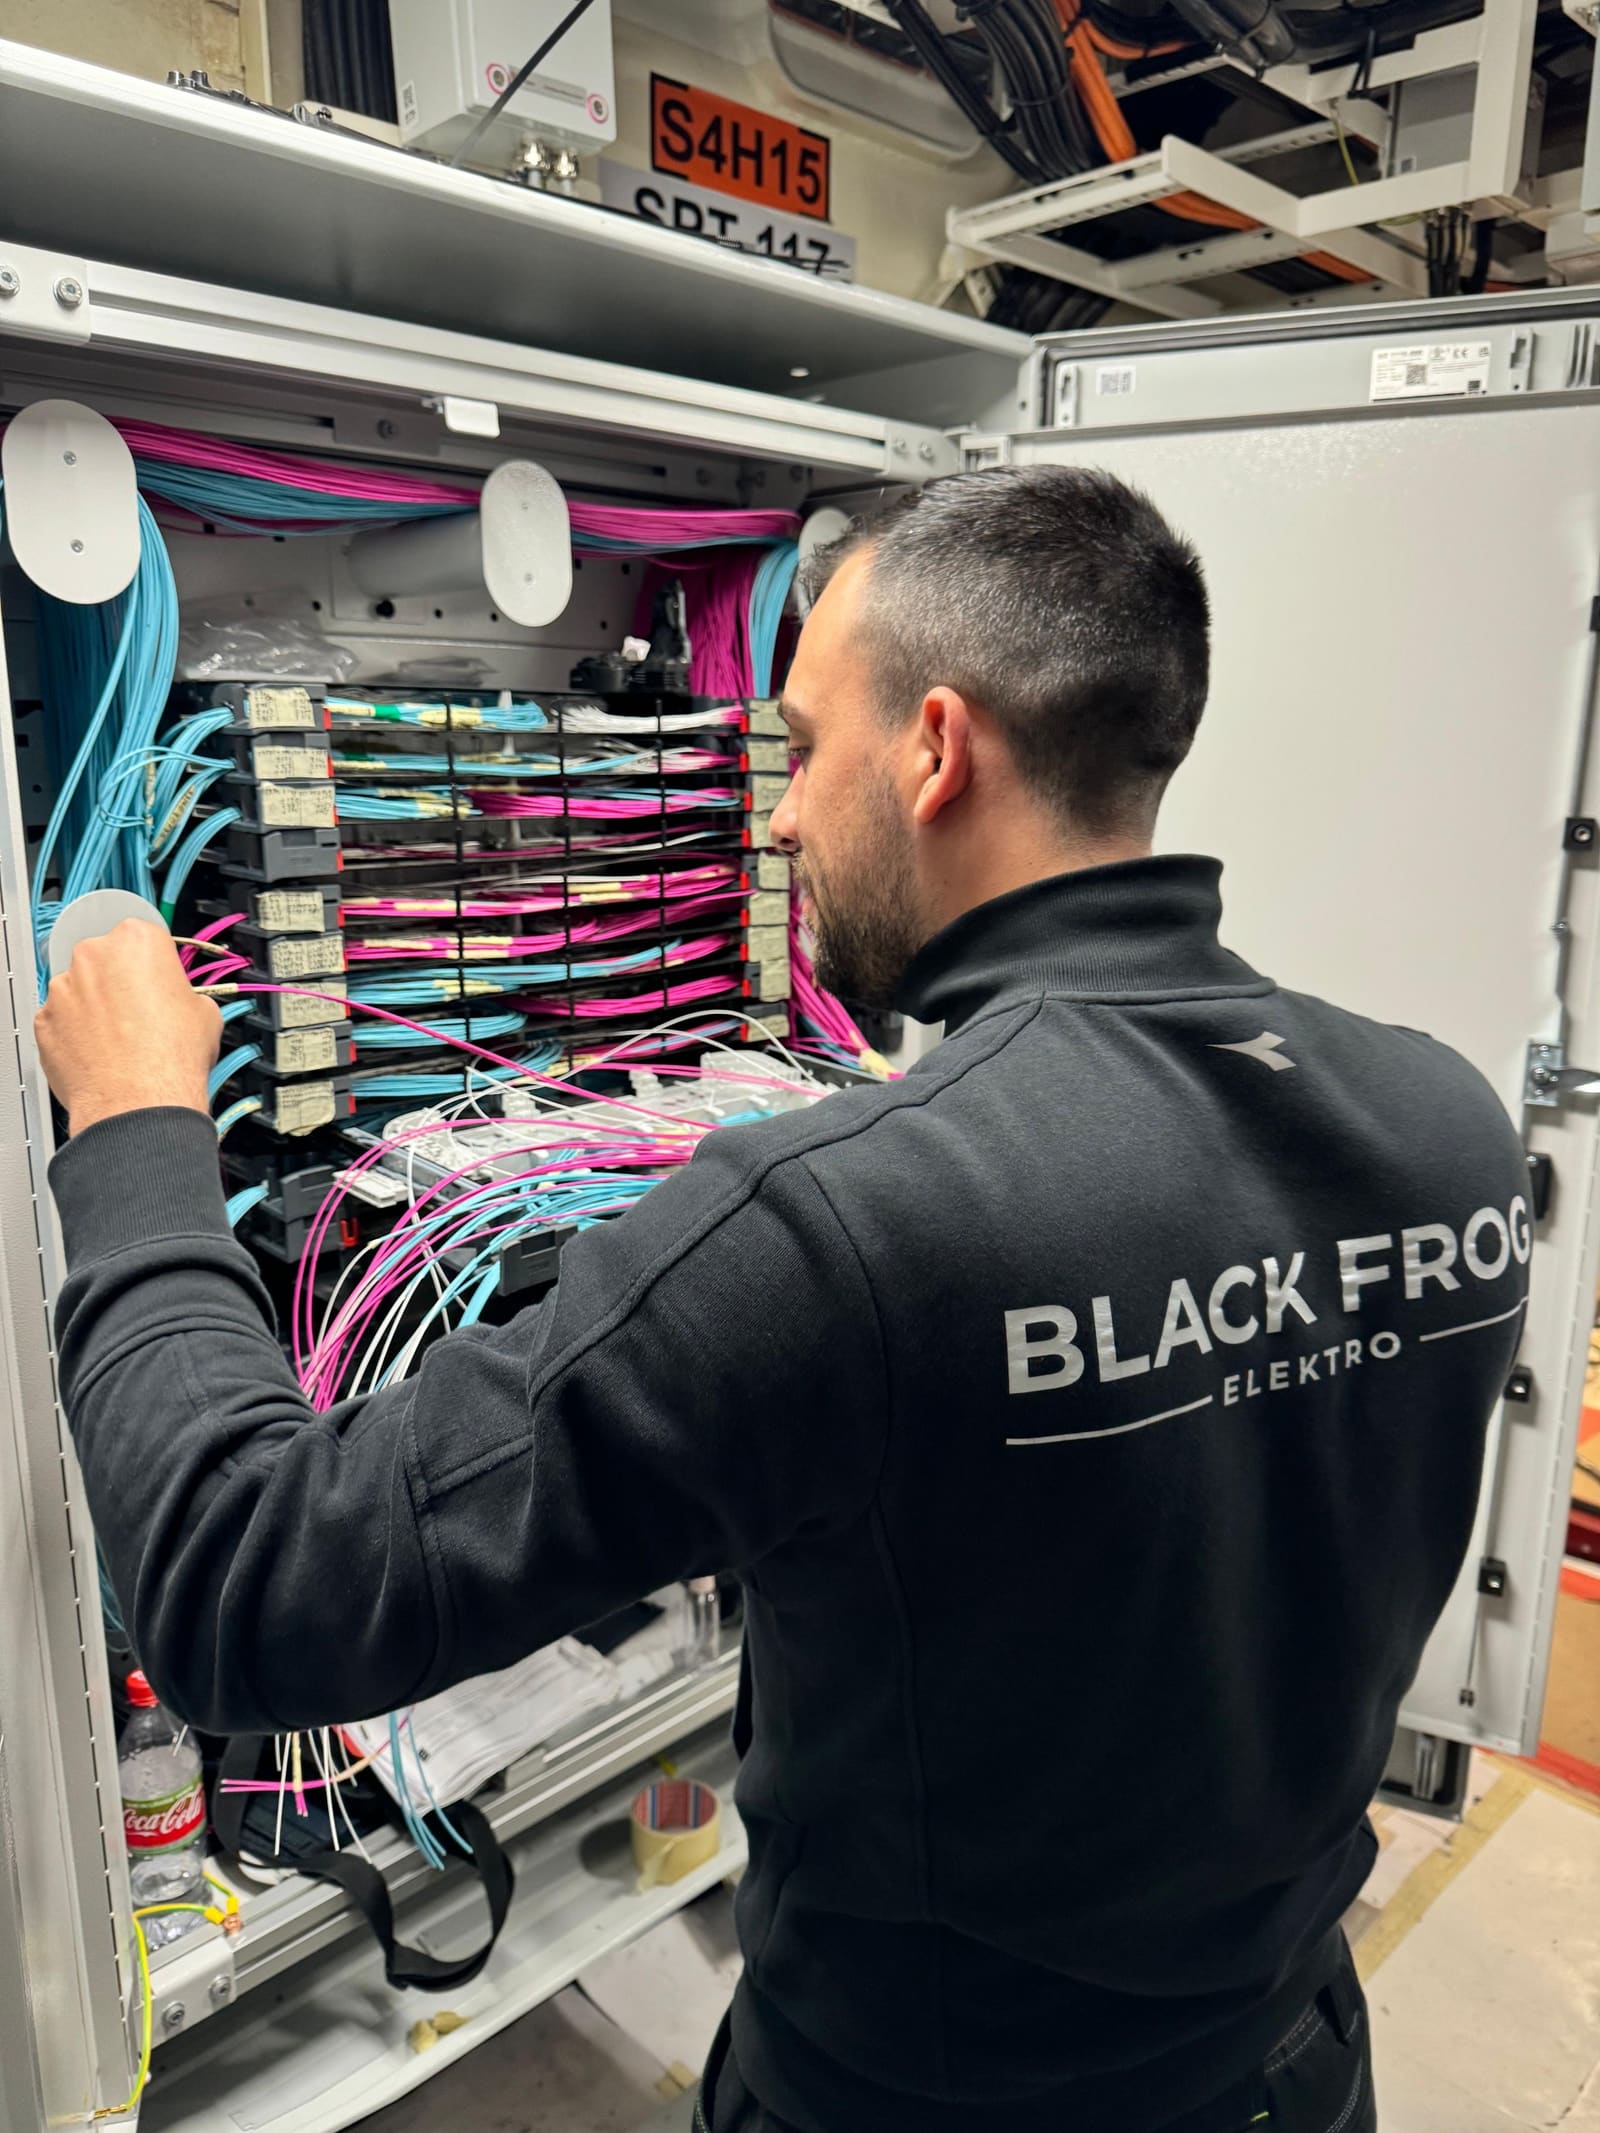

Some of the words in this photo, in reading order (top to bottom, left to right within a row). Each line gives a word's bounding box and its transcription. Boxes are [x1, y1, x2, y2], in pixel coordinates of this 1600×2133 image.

[660, 98, 821, 205] S4H15
[757, 223, 831, 276] 117
[1004, 1252, 1317, 1395] BLACK
[1337, 1195, 1531, 1312] FROG
[1222, 1331, 1401, 1406] ELEKTRO
